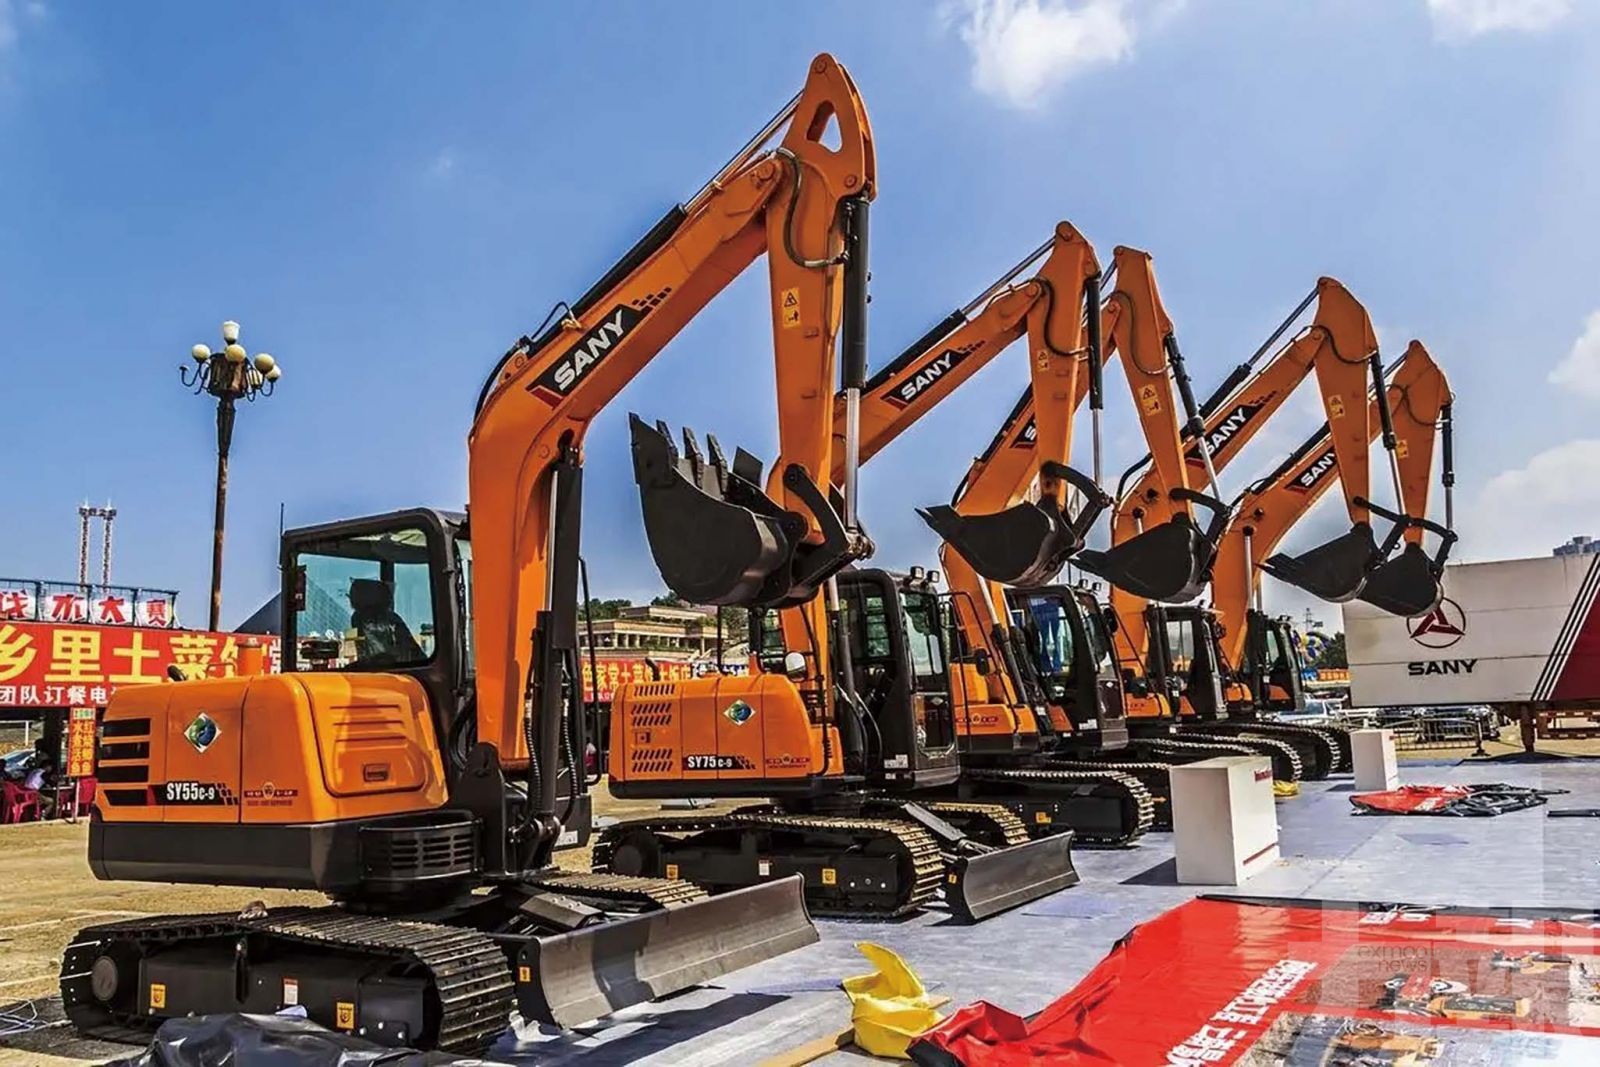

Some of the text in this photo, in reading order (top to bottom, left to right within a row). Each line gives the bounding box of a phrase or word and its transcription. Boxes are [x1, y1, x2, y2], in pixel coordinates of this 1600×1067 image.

[554, 309, 625, 391] SANY
[901, 351, 951, 400] SANY
[1407, 658, 1478, 676] SANY
[0, 685, 116, 705] 团队订餐电
